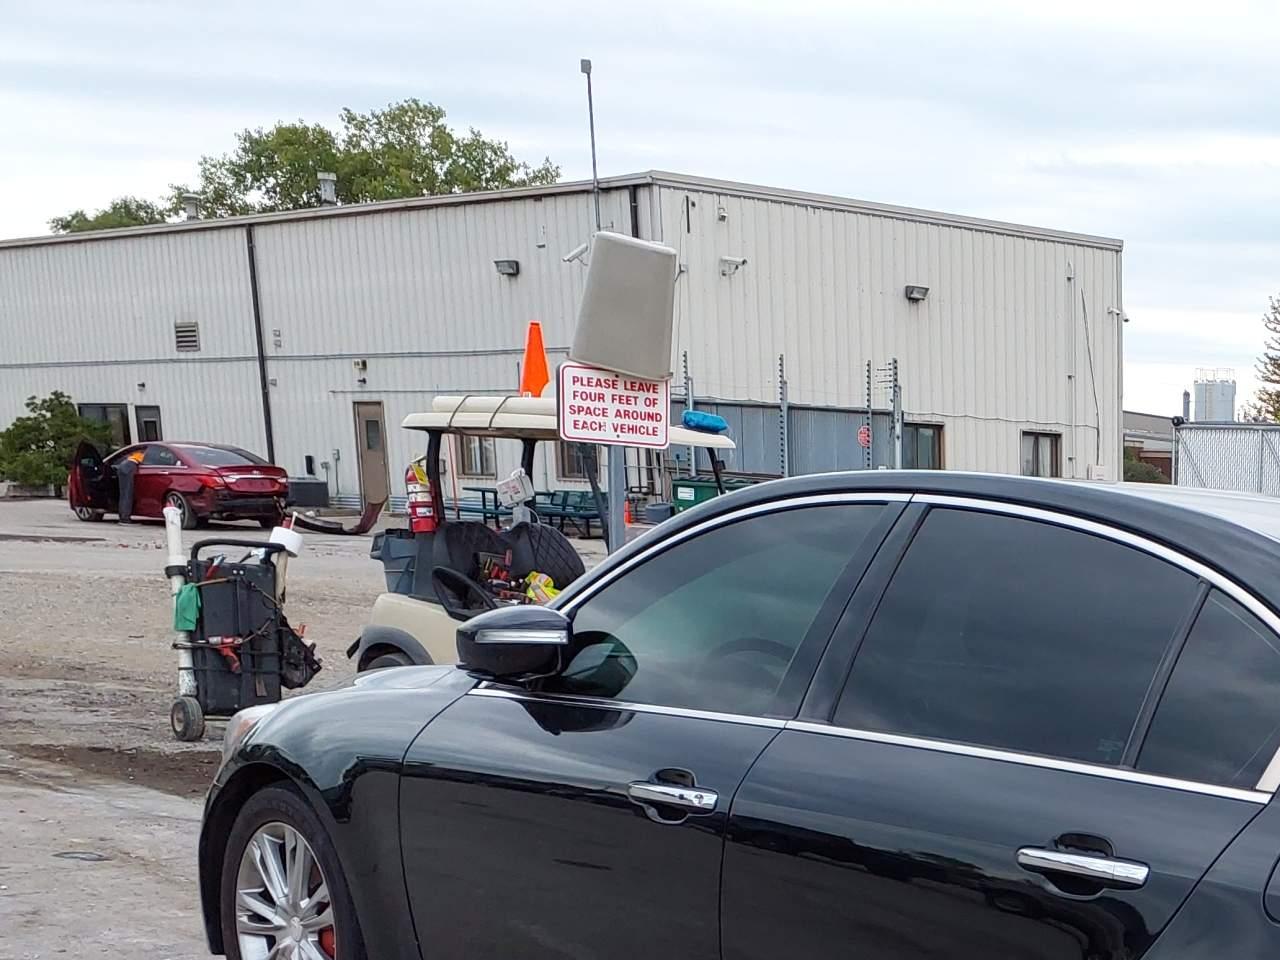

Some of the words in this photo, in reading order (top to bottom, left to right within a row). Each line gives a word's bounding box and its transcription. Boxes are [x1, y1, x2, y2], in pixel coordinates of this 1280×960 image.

[572, 376, 618, 389] PLEASE
[624, 380, 659, 394] LEAVE
[573, 390, 606, 403] FOUR
[611, 394, 639, 406] FEET
[644, 397, 658, 408] OF
[569, 404, 609, 418] SPACE
[614, 408, 662, 423] AROUND
[573, 419, 607, 432] EACH
[612, 423, 658, 437] VEHICLE
